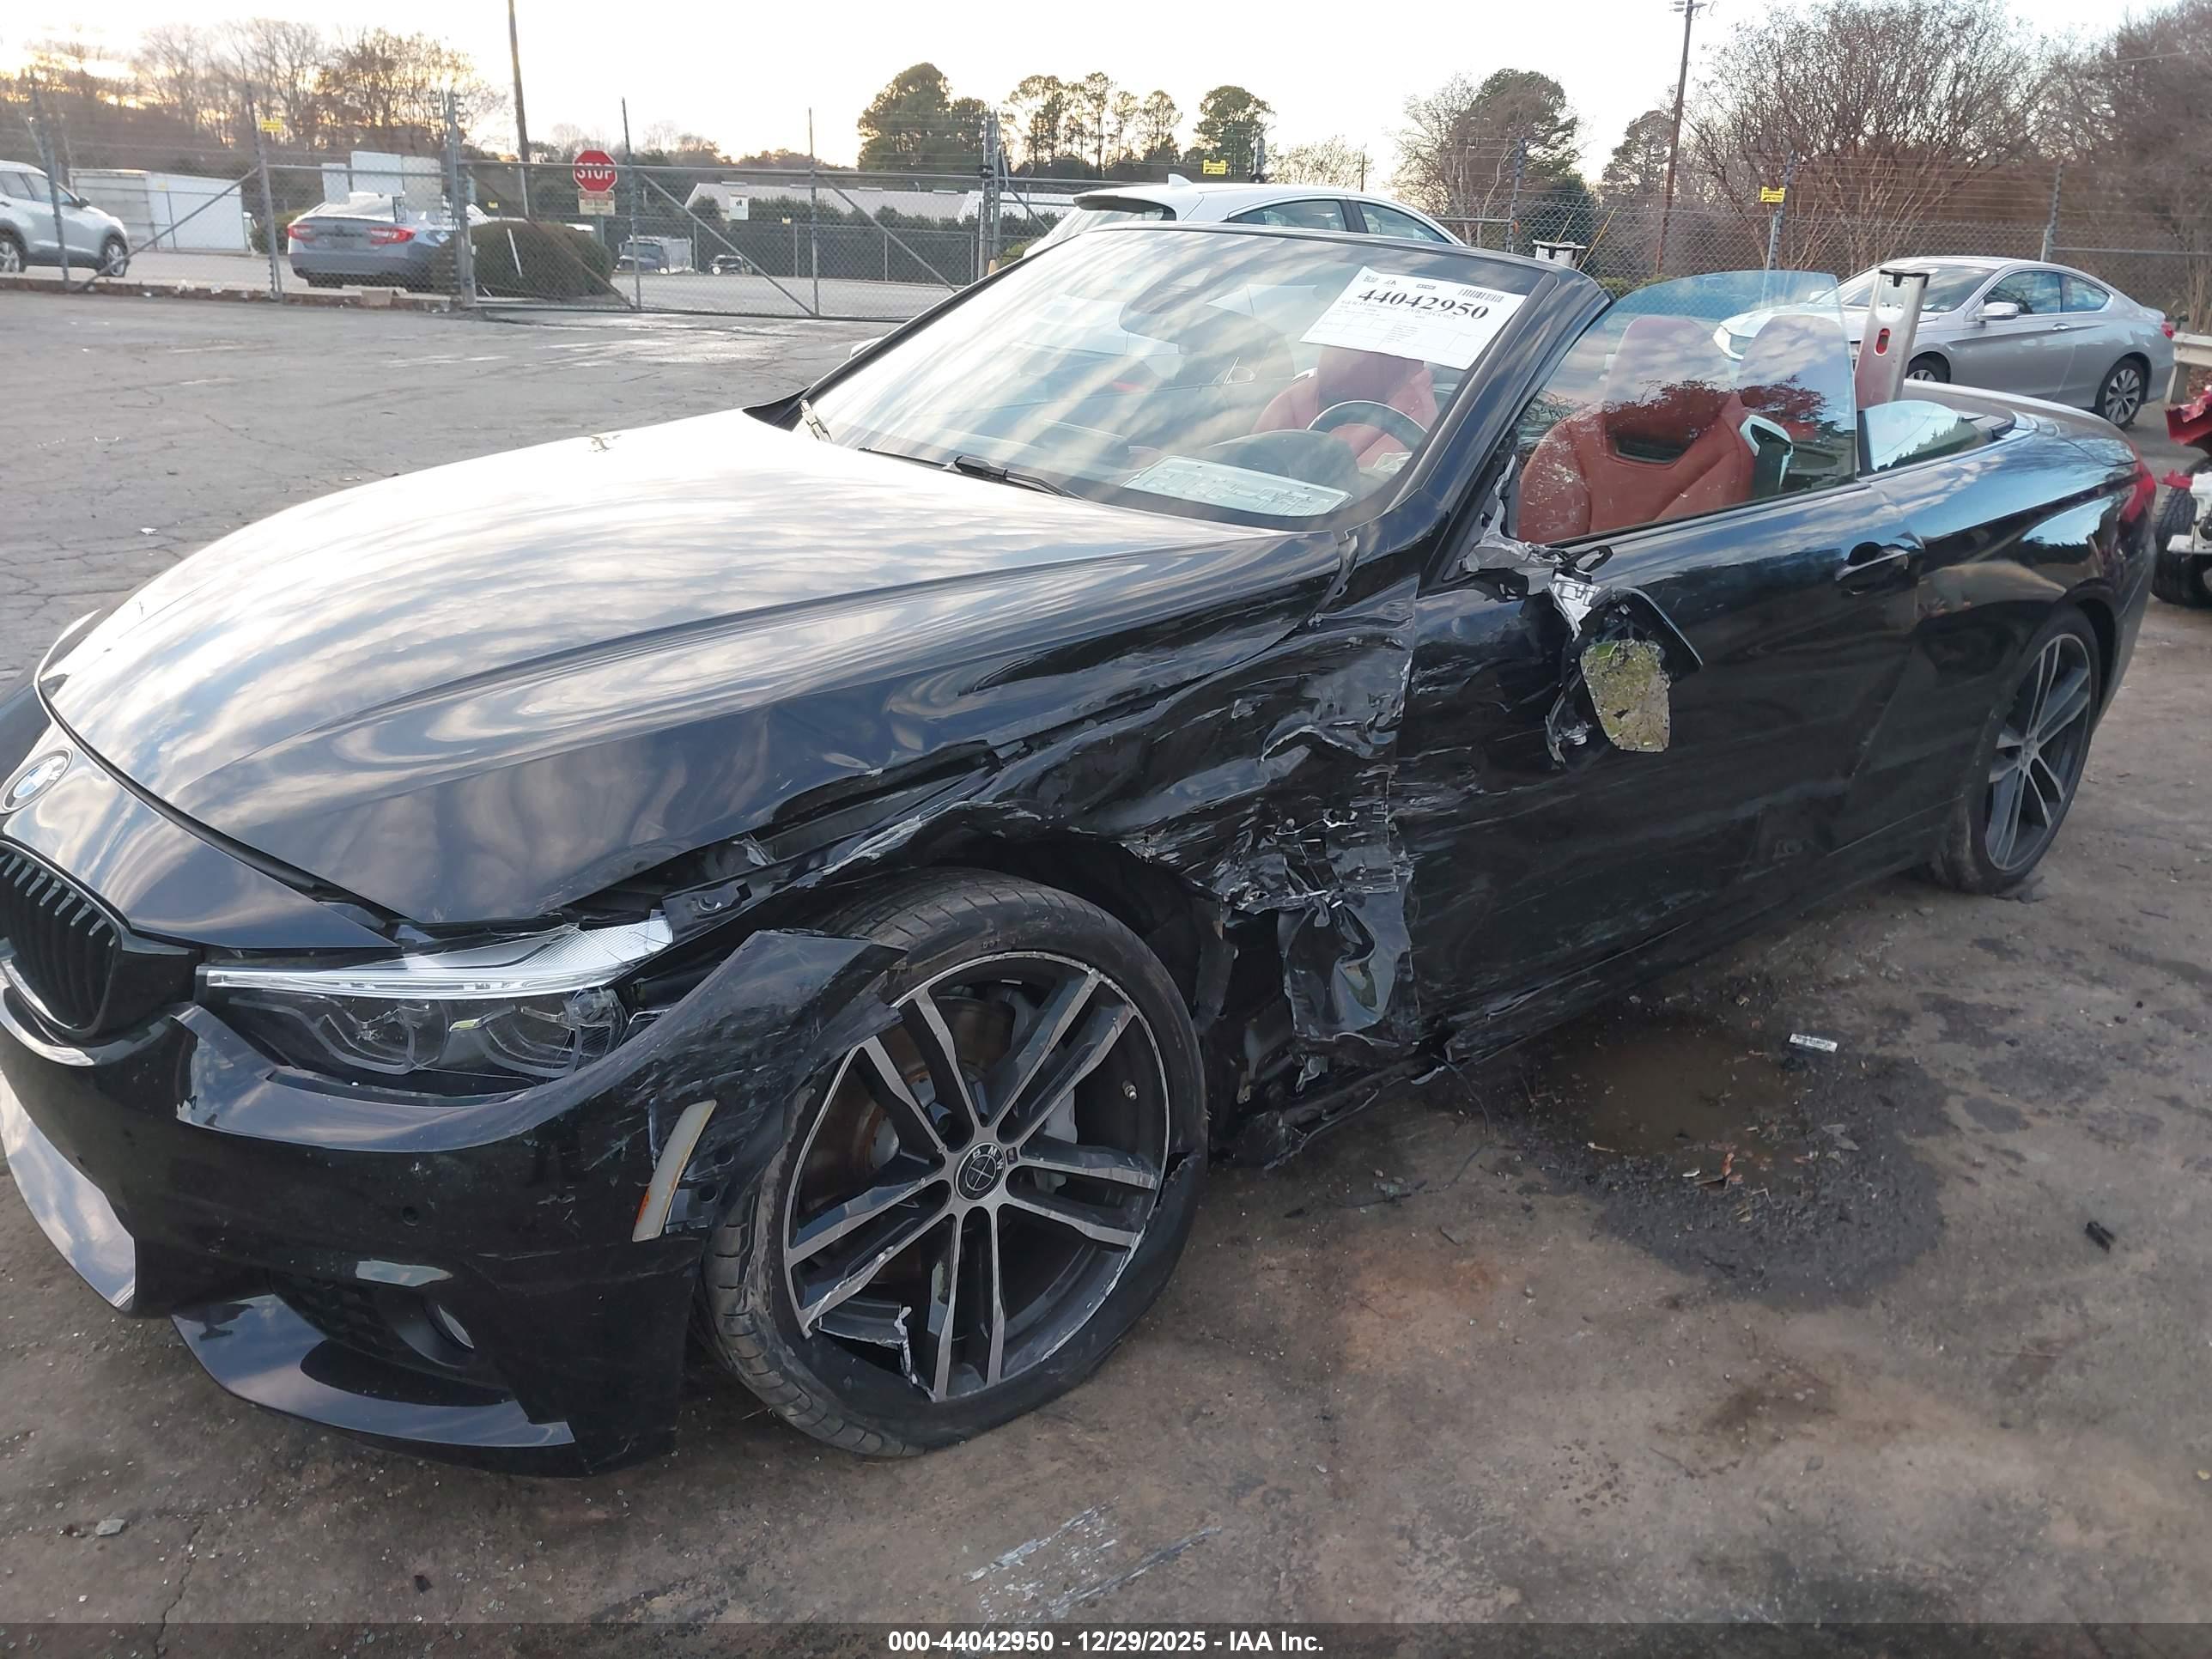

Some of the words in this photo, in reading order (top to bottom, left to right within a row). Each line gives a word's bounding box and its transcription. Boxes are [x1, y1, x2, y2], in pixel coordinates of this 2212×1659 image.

[576, 161, 612, 179] STOP
[1358, 289, 1489, 319] 44042950
[972, 1146, 1004, 1170] BMW
